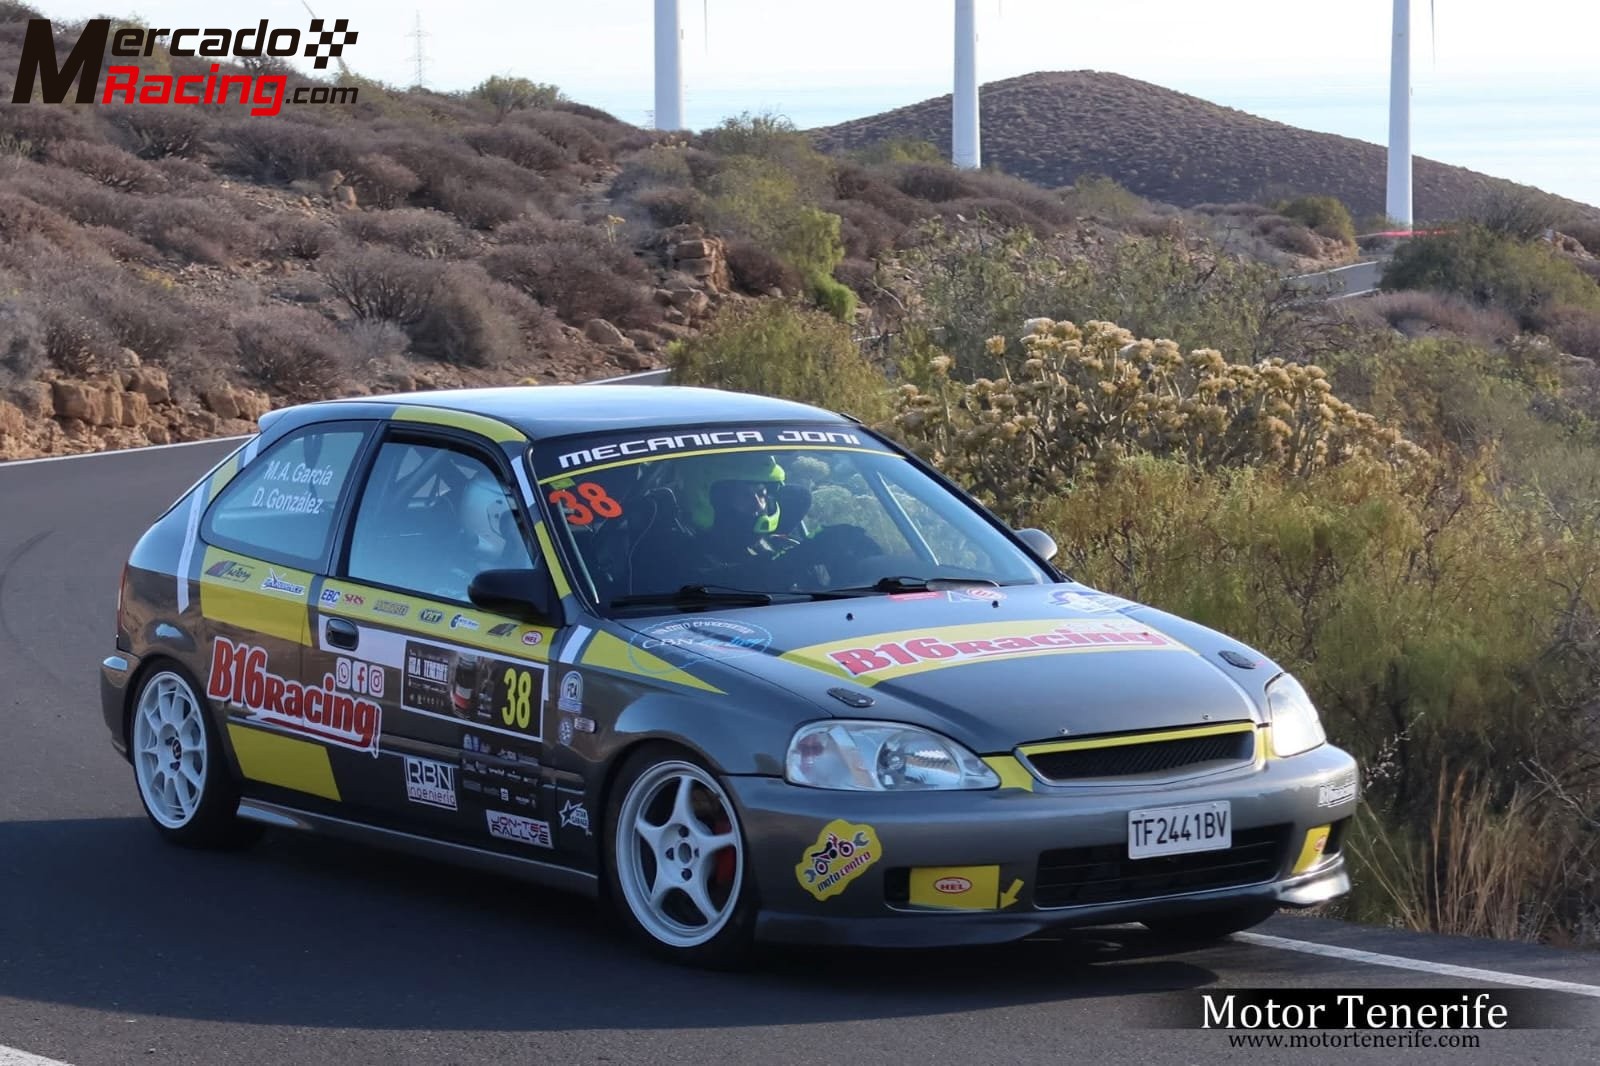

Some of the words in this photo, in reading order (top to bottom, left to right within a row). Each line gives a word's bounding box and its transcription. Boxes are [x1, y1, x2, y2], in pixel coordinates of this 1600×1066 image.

[559, 430, 763, 469] MECANICA
[777, 430, 861, 446] JONI
[292, 463, 333, 486] García
[251, 486, 264, 507] D.
[549, 482, 623, 526] 38
[321, 589, 340, 602] EBC
[502, 668, 531, 729] 38
[408, 758, 453, 791] RBN
[491, 824, 550, 845] RALLYE
[939, 882, 967, 891] HEL
